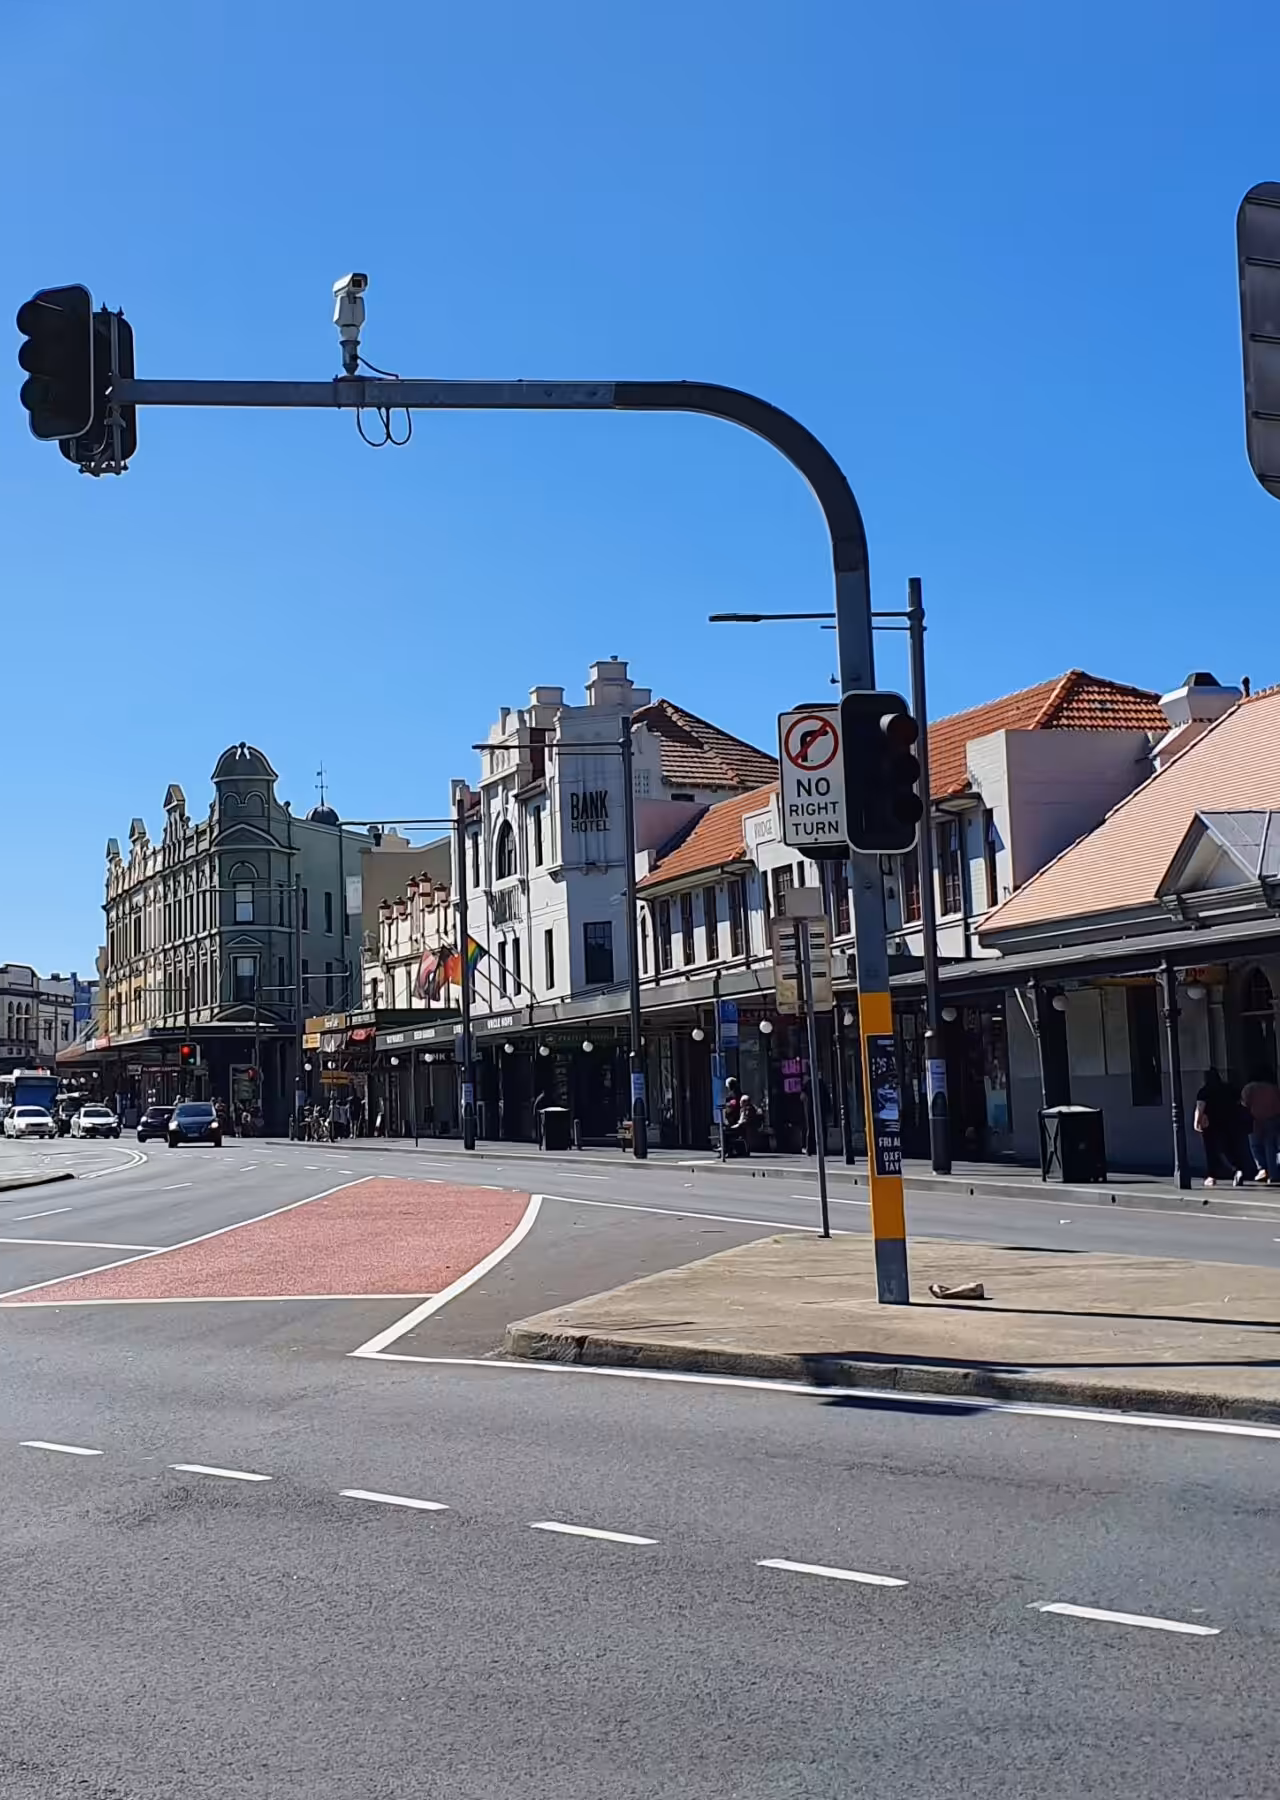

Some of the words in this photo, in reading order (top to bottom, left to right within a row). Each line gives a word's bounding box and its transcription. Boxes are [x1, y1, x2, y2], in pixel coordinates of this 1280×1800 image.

[796, 777, 831, 798] NO
[570, 790, 609, 820] BANK
[789, 801, 840, 817] RIGHT
[571, 819, 611, 832] HOTEL
[791, 820, 839, 836] TURN
[878, 1137, 892, 1148] FRI
